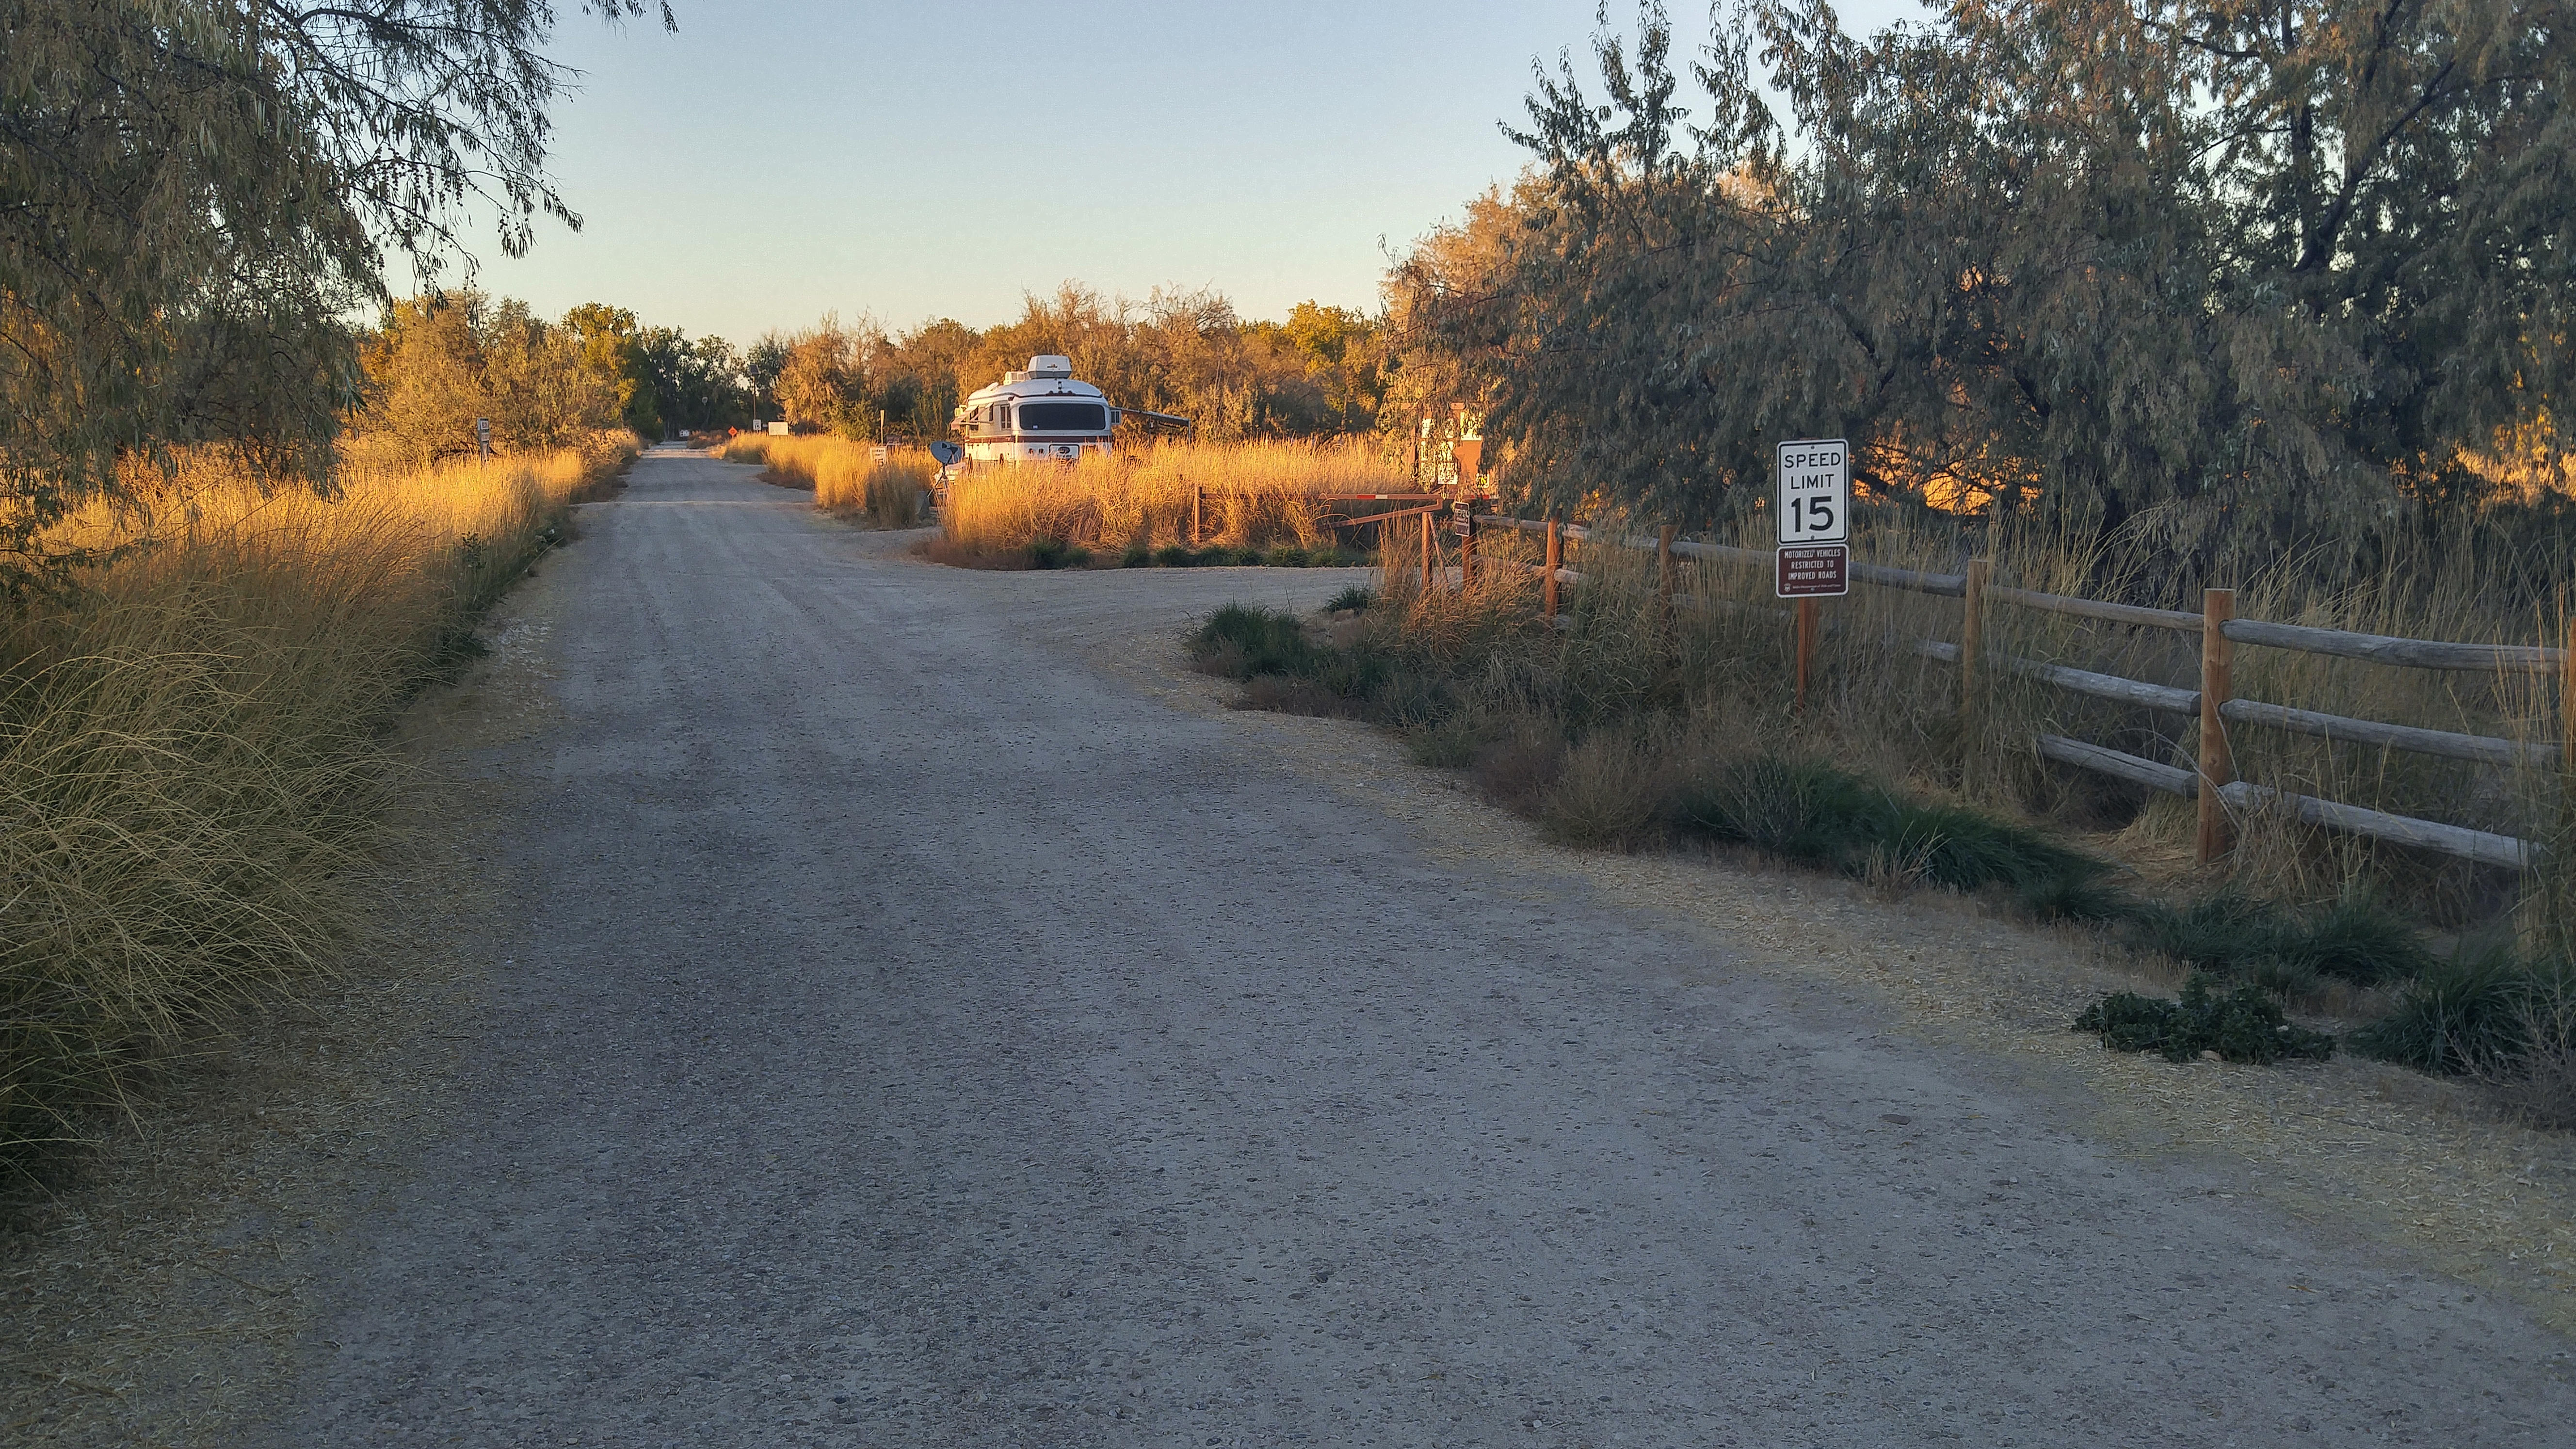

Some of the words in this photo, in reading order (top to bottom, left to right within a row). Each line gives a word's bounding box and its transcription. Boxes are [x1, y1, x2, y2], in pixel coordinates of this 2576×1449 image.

[1785, 452, 1840, 468] SPEED
[1791, 474, 1834, 489] LIMIT
[1791, 496, 1834, 532] 15
[1785, 549, 1814, 559] MOTORIZED
[1817, 548, 1841, 558] VEHICLES
[1791, 561, 1824, 569] RESTRICTED
[1788, 572, 1816, 580] IMPROVED
[1818, 571, 1836, 579] ROADS
